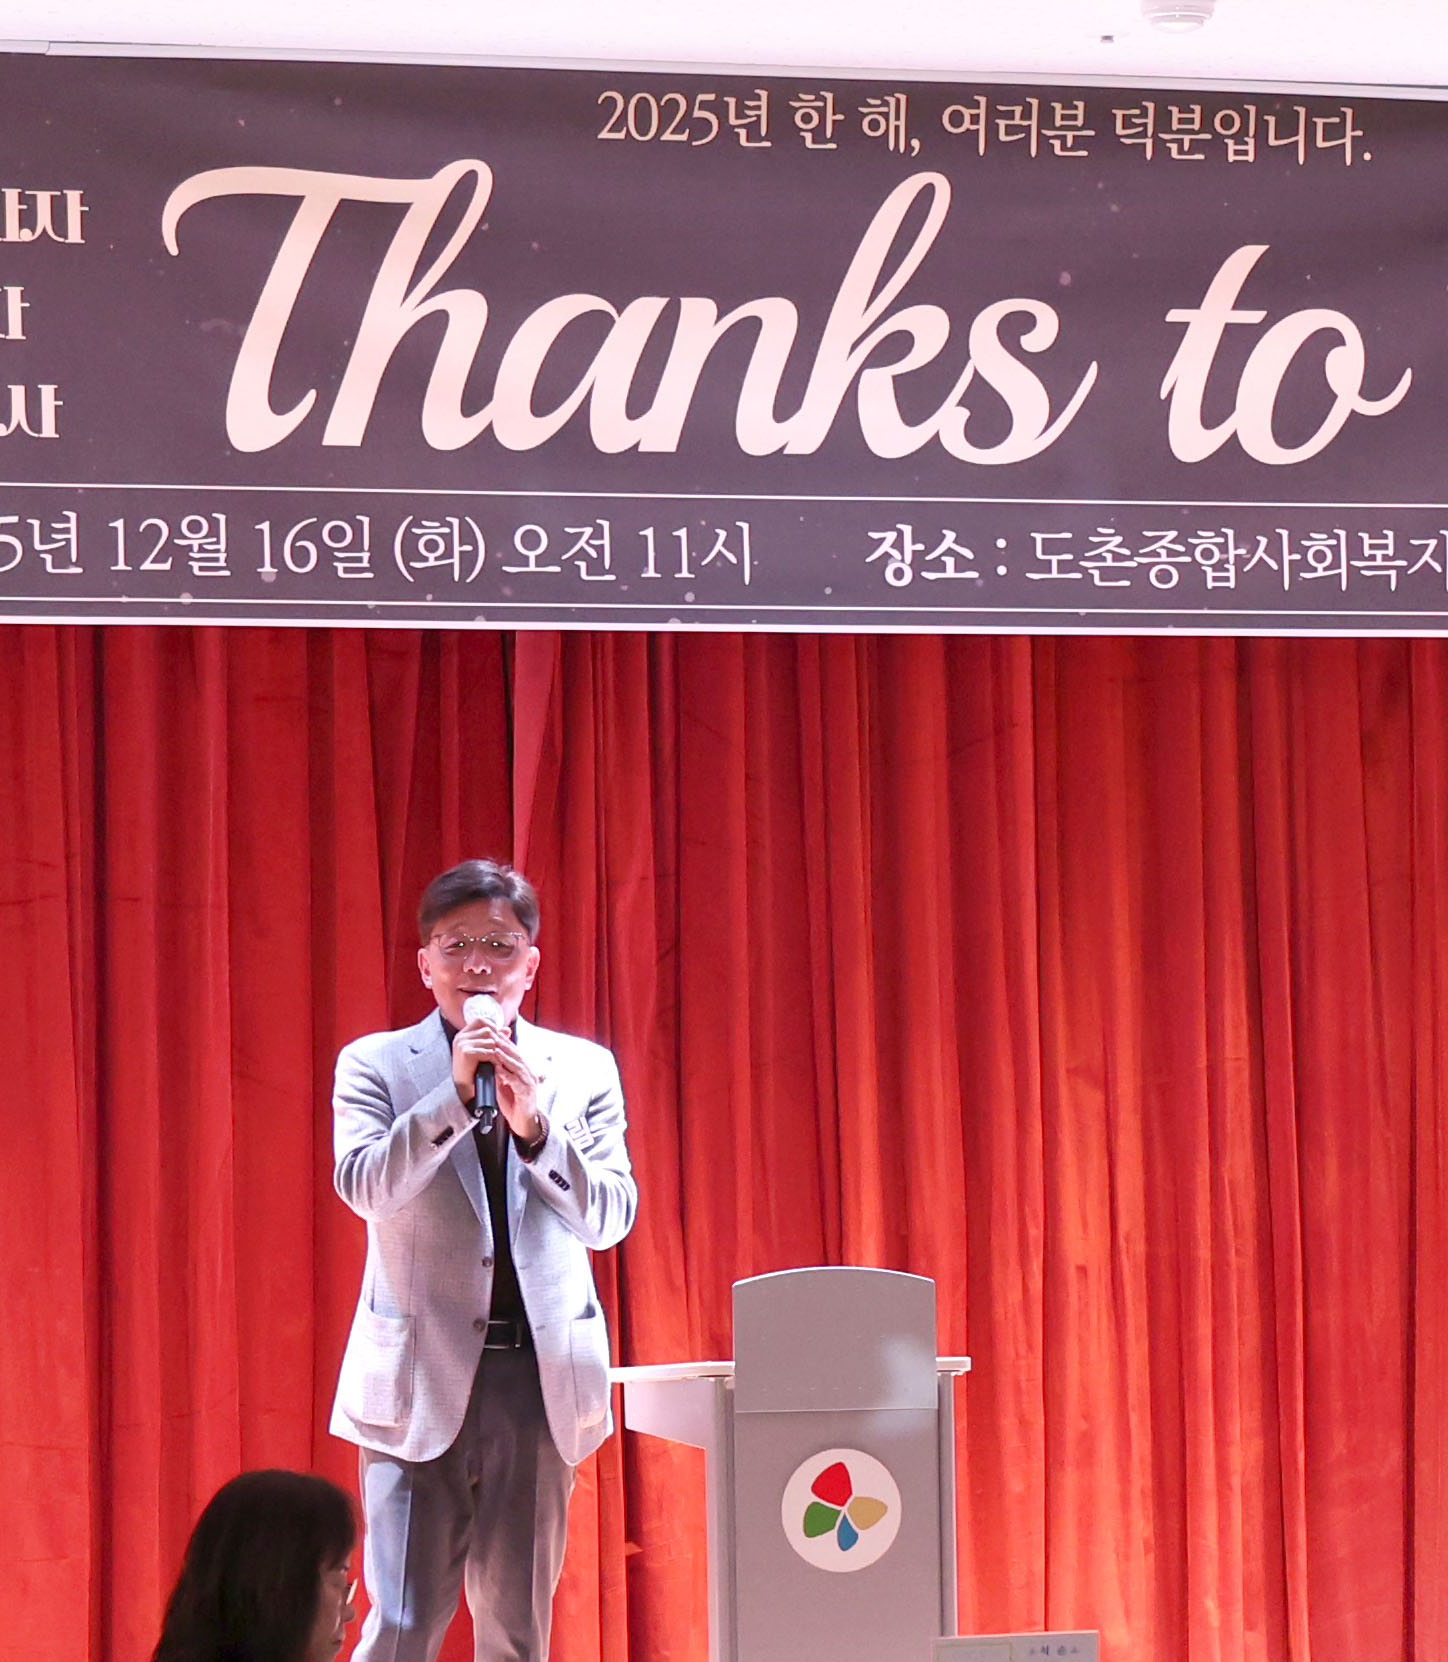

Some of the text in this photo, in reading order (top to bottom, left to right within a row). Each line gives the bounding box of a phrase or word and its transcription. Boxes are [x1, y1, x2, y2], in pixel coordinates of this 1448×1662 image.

[598, 90, 1374, 165] 2025년 한 해, 여러분 덕분입니다.
[162, 158, 1098, 465] Thanks
[1160, 245, 1411, 464] to
[109, 513, 230, 576] 12월
[255, 515, 374, 580] 16일
[395, 516, 485, 582] (화)
[502, 519, 616, 580] 오전
[639, 522, 750, 585] 11시
[865, 524, 979, 586] 장소
